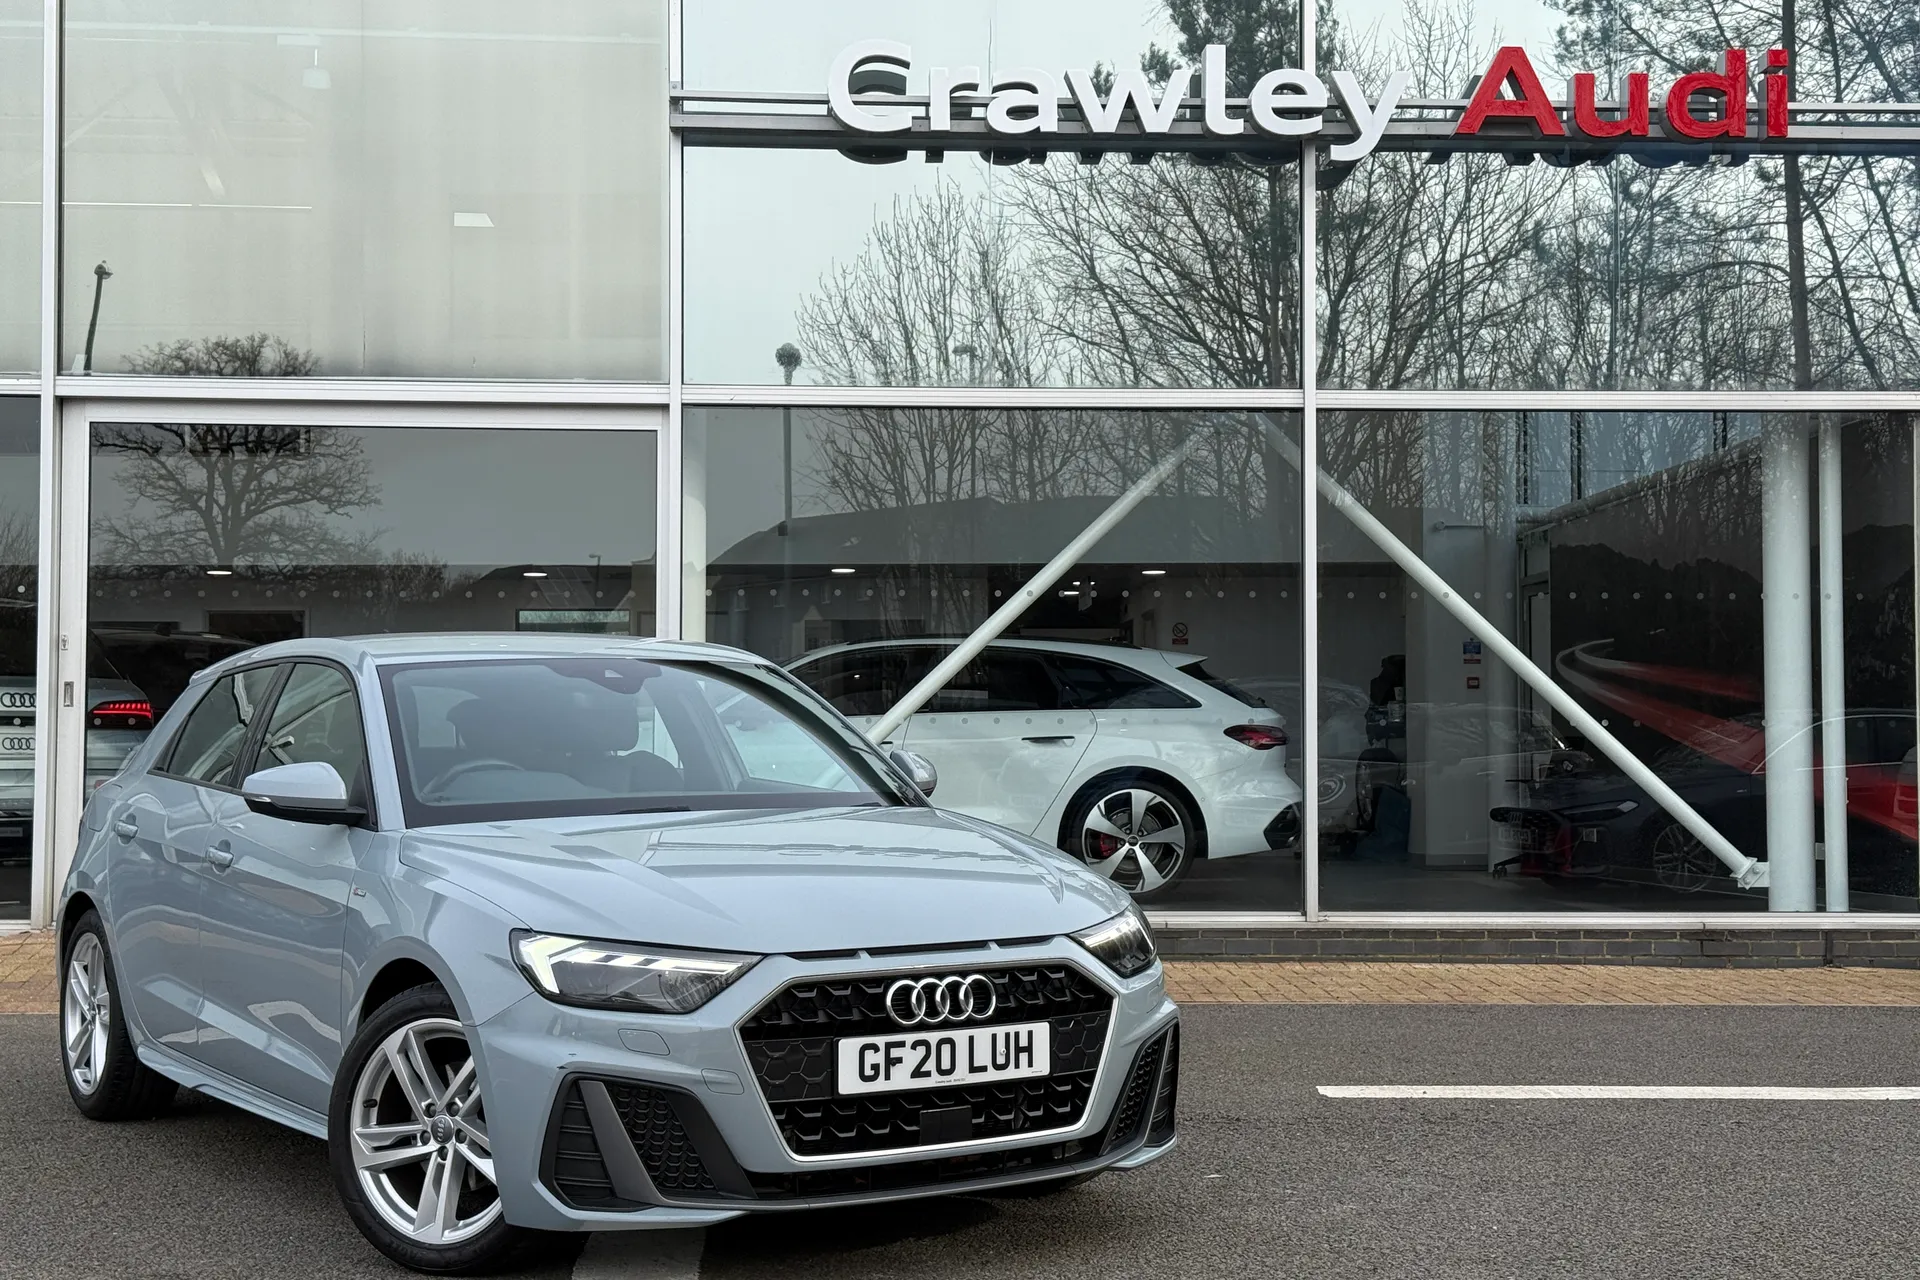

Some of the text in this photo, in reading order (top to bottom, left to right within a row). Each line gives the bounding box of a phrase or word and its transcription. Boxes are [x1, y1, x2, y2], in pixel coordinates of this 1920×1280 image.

[827, 38, 1789, 162] Crawley Audi
[858, 1029, 1034, 1083] GF20 LUH
